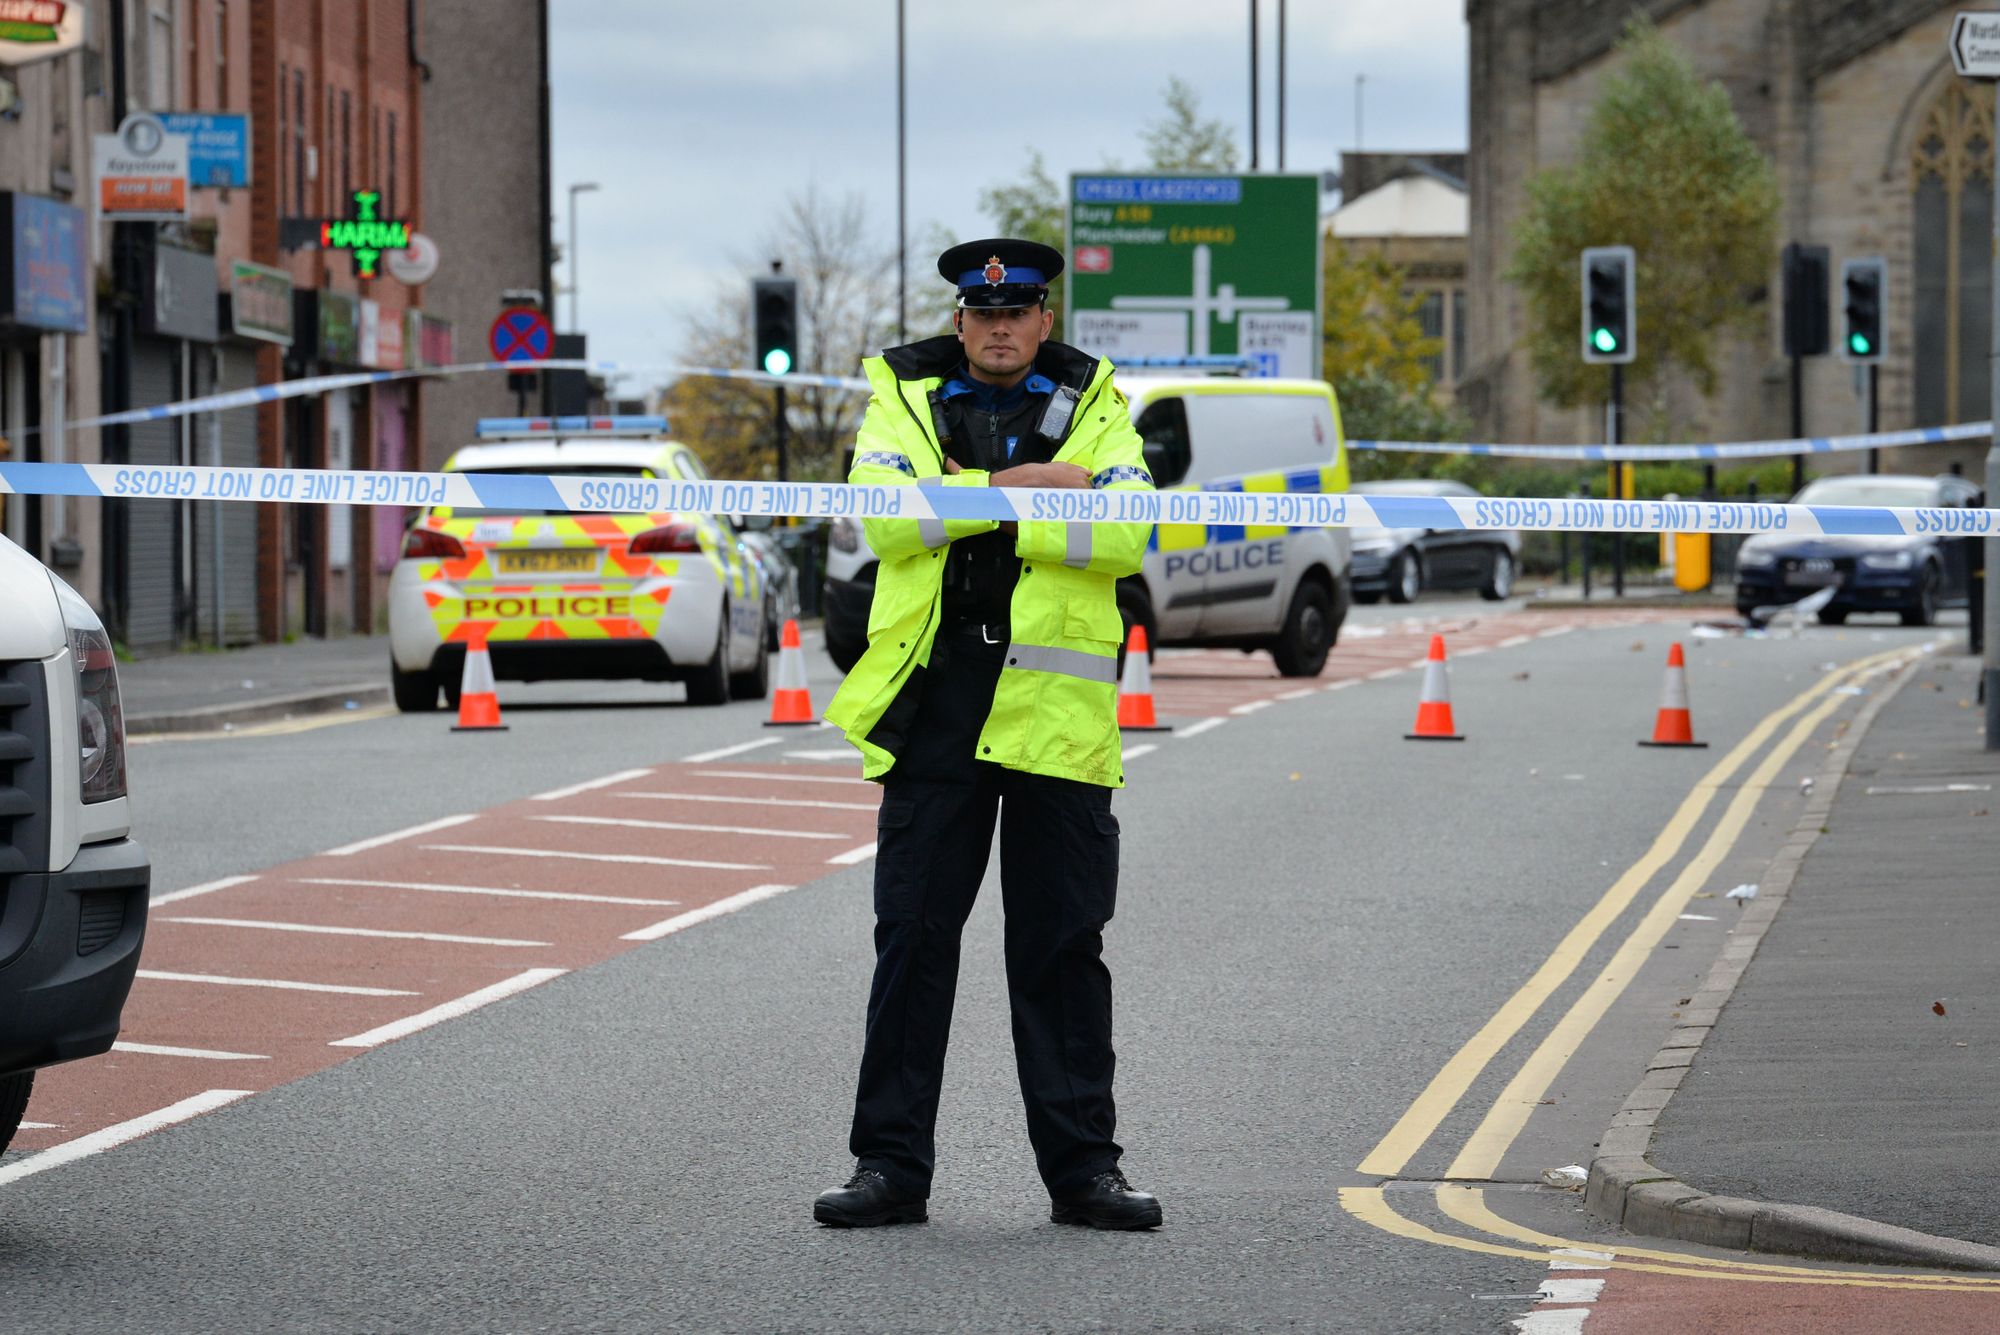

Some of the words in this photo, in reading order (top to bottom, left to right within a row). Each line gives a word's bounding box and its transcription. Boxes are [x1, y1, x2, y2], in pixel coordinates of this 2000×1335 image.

[1075, 205, 1112, 224] Bury
[1075, 227, 1166, 243] Manchester
[114, 470, 196, 496] CROSS
[202, 472, 253, 497] NOT
[260, 473, 294, 498] DO
[301, 474, 355, 500] LINE
[362, 475, 447, 503] POLICE
[580, 481, 659, 510] CROSS
[665, 483, 713, 511] NOT
[722, 484, 753, 511] DO
[763, 485, 813, 512] LINE
[820, 486, 901, 515] POLICE
[1031, 491, 1108, 519] CROSS
[1115, 494, 1161, 520] NOT
[1170, 494, 1200, 520] DO
[1209, 495, 1258, 521] LINE
[1266, 496, 1346, 523] POLICE
[1475, 500, 1552, 526] CROSS
[1558, 501, 1604, 527] NOT
[1612, 502, 1644, 527] DO
[1652, 503, 1701, 528] LINE
[1708, 505, 1788, 529] POLICE
[1915, 509, 1991, 533] CROSS
[1165, 541, 1284, 579] POLICE
[465, 597, 631, 618] POLICE
